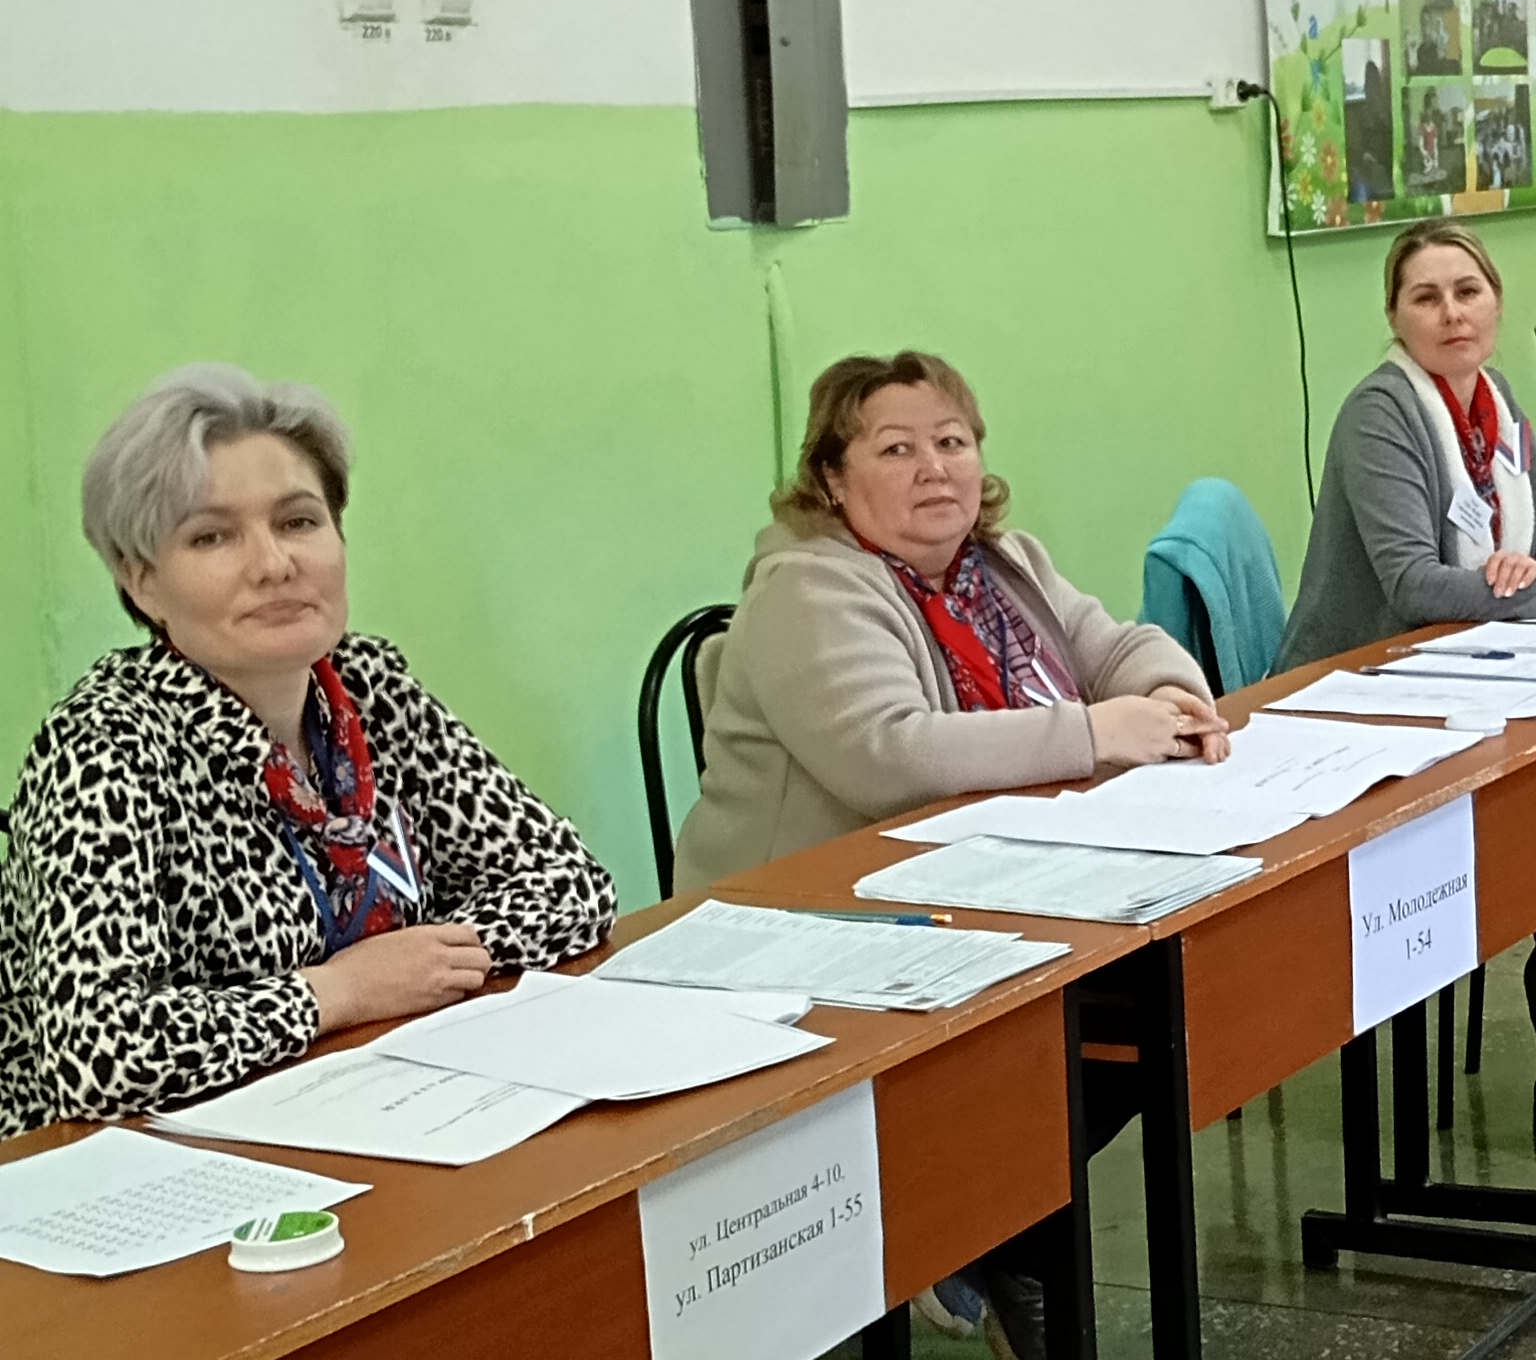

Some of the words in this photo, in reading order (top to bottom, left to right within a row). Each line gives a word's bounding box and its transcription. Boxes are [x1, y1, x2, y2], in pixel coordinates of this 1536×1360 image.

[1362, 911, 1385, 938] Ул.
[1388, 872, 1468, 927] Молодежная
[1404, 927, 1433, 960] 1-54
[674, 1286, 703, 1317] ул.
[706, 1217, 824, 1295] Партизанская
[830, 1192, 863, 1229] 1-55
[689, 1234, 712, 1260] ул.
[716, 1184, 808, 1243] Центральная
